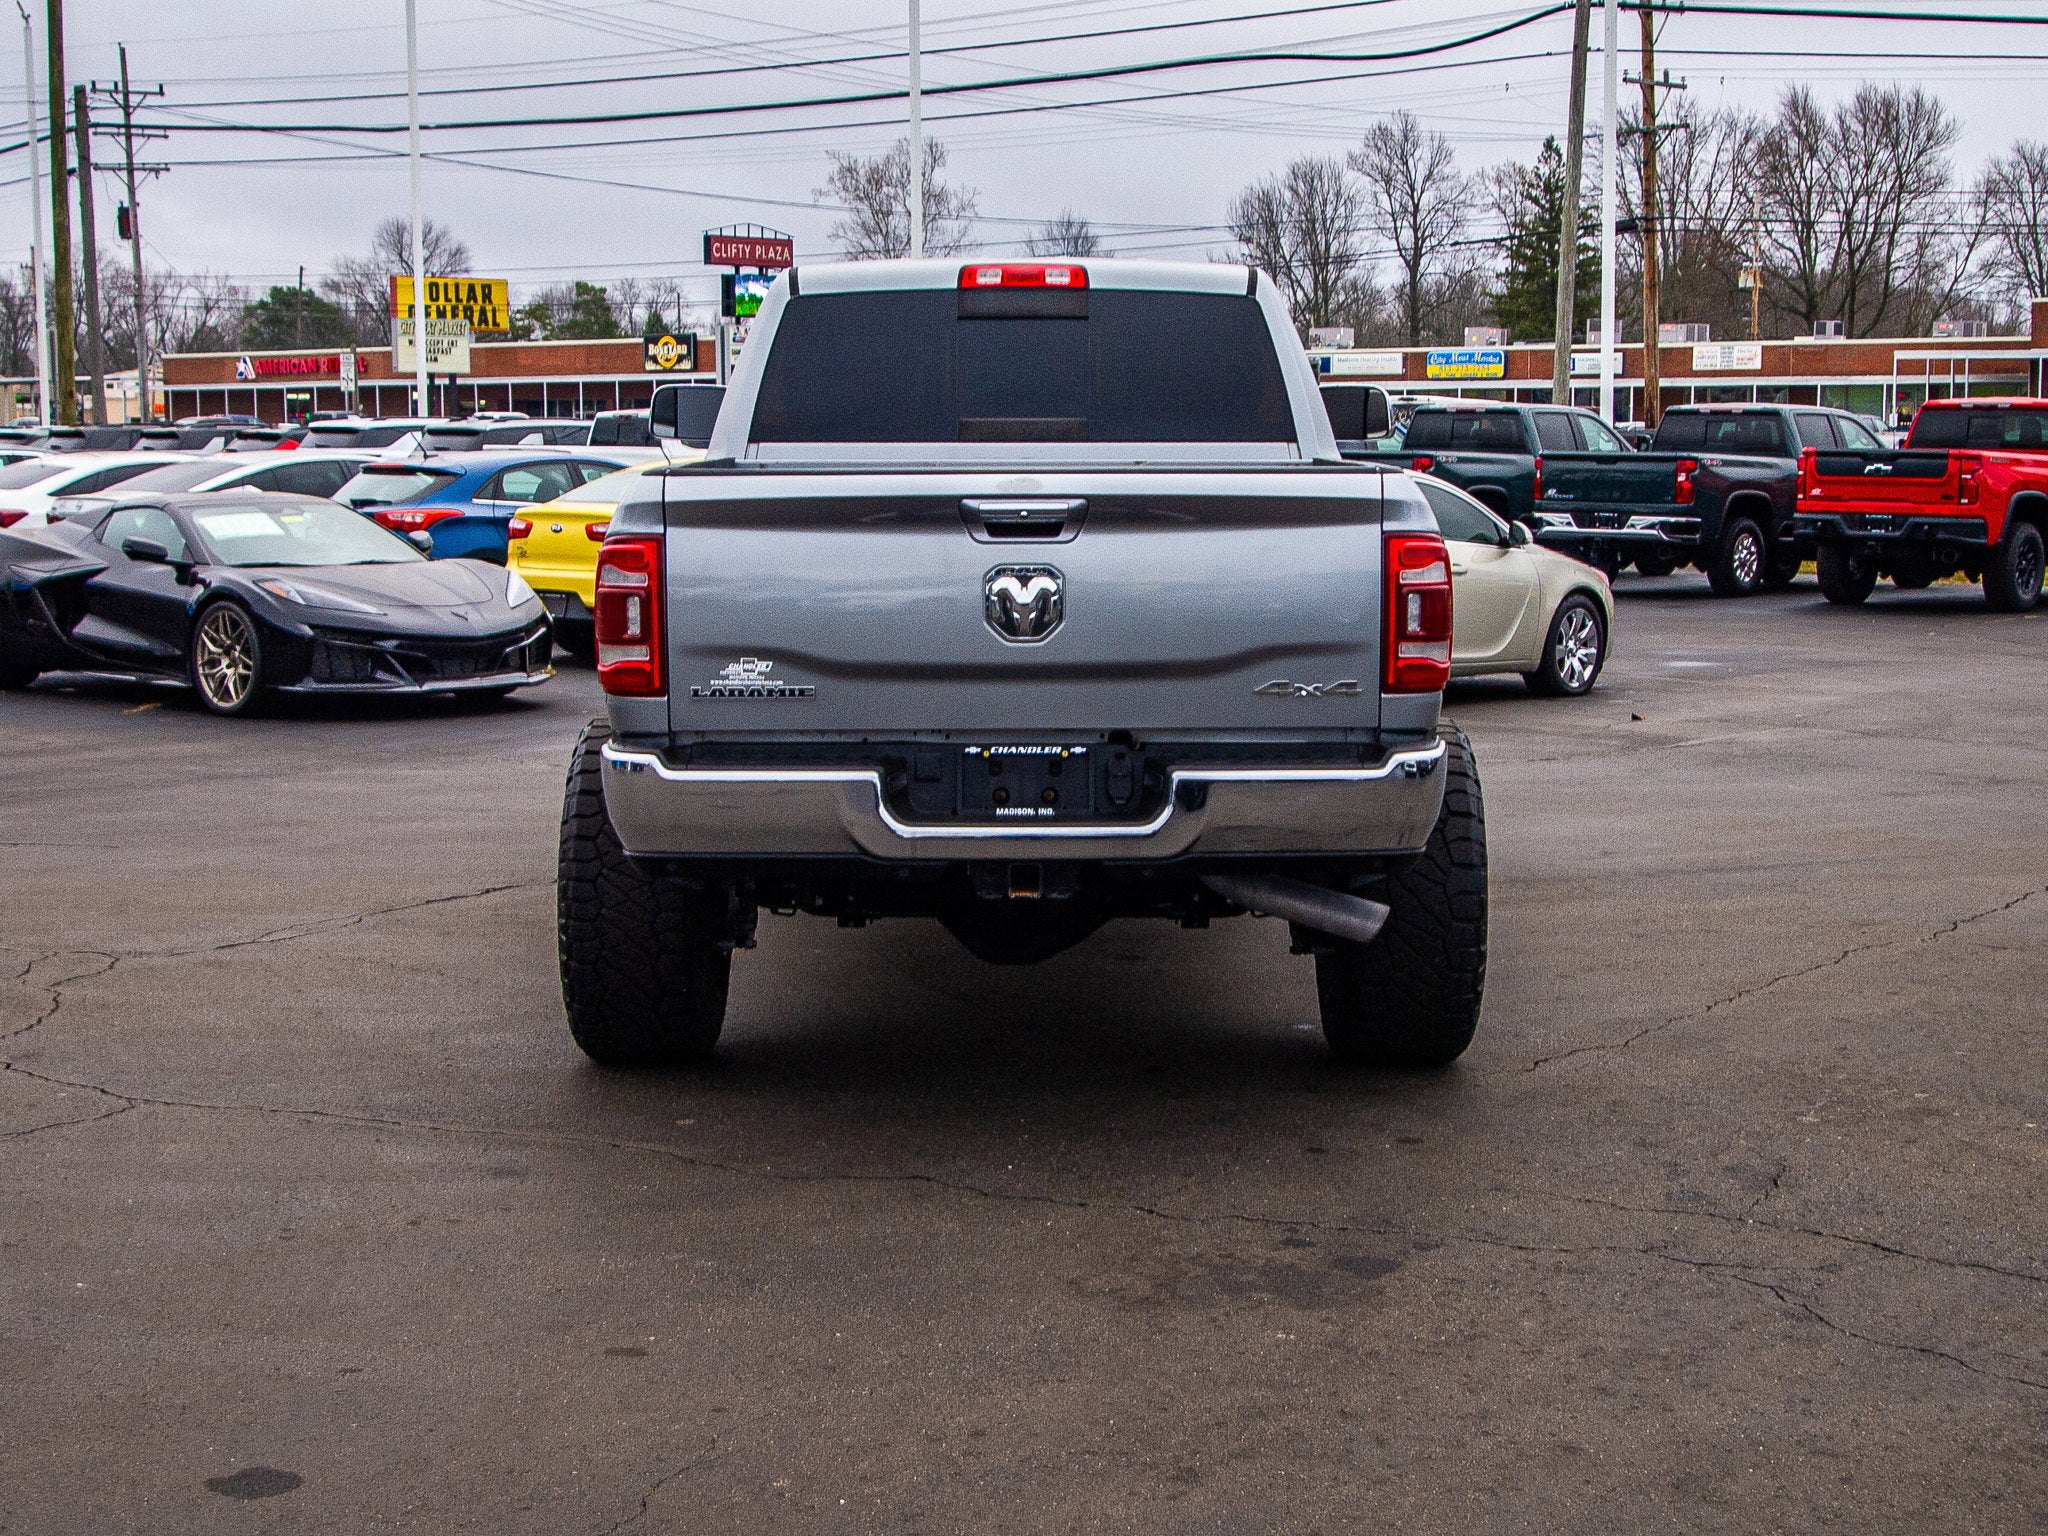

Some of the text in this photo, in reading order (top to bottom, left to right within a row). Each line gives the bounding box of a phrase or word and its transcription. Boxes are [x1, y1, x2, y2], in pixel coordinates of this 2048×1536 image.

[712, 242, 791, 262] CLIFTY PLAZA
[413, 281, 493, 304] OLLAR
[254, 357, 318, 374] AMERICAN
[690, 685, 815, 698] LARAMIE
[990, 745, 1062, 755] CHANDLER
